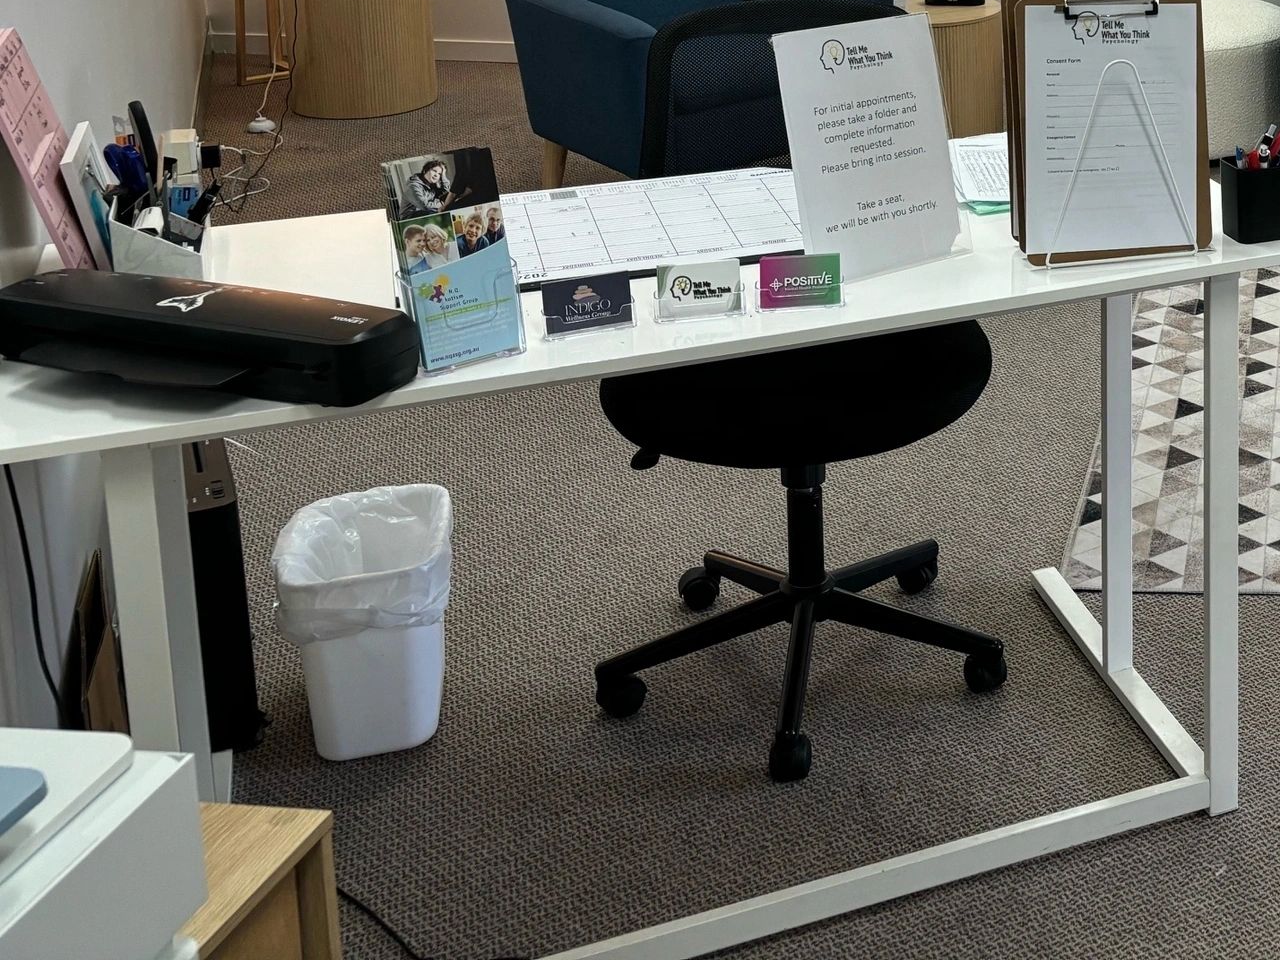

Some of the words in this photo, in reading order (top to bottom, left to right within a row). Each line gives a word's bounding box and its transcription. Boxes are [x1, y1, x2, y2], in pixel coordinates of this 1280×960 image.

[1101, 20, 1113, 29] Tell
[1114, 20, 1124, 29] Me
[1101, 30, 1118, 39] What
[1120, 30, 1131, 39] You
[1132, 30, 1150, 38] Think
[846, 46, 858, 56] Tell
[858, 45, 868, 54] Me
[848, 56, 864, 65] What
[864, 54, 876, 64] You
[876, 51, 893, 60] Think
[813, 107, 828, 116] For
[830, 101, 854, 113] initial
[856, 91, 917, 109] appointments,
[817, 119, 846, 132] please
[847, 113, 866, 125] take
[874, 108, 900, 119] folder
[901, 104, 917, 114] and
[824, 129, 865, 144] complete
[866, 120, 916, 136] information
[849, 137, 895, 154] requested.
[821, 162, 849, 174] Please
[851, 157, 874, 168] bring
[875, 152, 892, 163] into
[894, 145, 926, 160] session.
[857, 201, 876, 212] Take
[885, 194, 905, 204] seat,
[825, 224, 839, 233] we
[841, 219, 856, 230] will
[858, 216, 869, 226] be
[870, 211, 889, 222] with
[890, 210, 907, 220] you
[908, 200, 938, 214] shortly.
[439, 301, 462, 311] Support
[462, 297, 479, 306] Group
[565, 299, 611, 316] INDIGO
